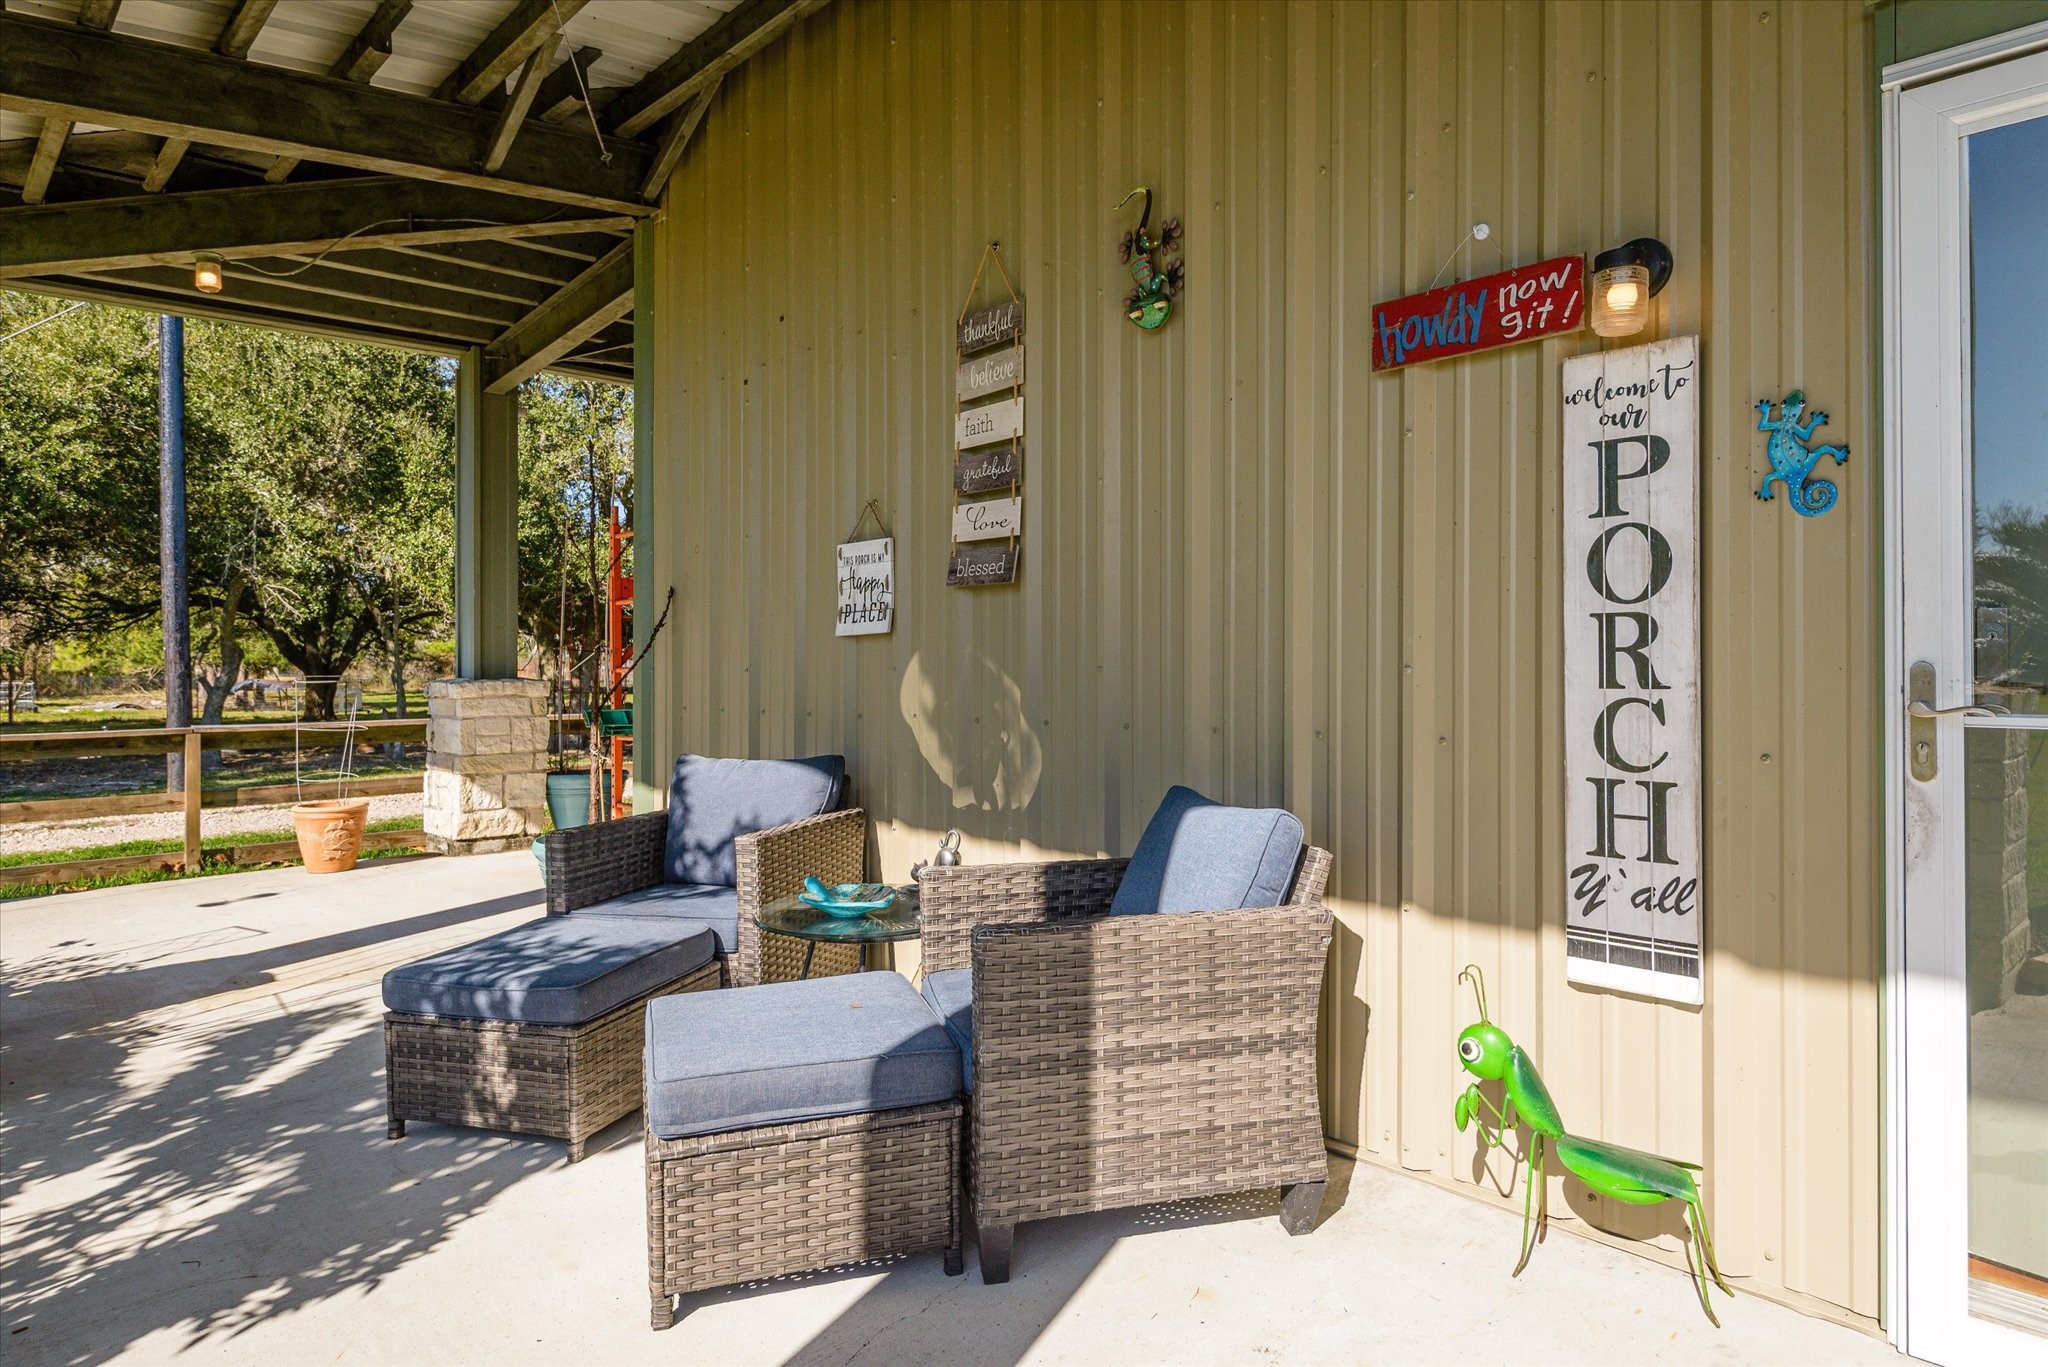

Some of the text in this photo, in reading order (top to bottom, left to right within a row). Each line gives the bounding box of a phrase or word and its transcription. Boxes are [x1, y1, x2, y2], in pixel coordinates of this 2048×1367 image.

[1499, 263, 1572, 313] now
[963, 304, 1014, 343] thankful
[1378, 288, 1488, 365] howdy
[970, 360, 1015, 389] believe
[1565, 360, 1694, 409] welcome to
[965, 413, 993, 437] faith
[1599, 403, 1648, 429] our
[962, 454, 1012, 491] grateful
[965, 506, 1011, 531] love
[843, 553, 885, 566] THIS PORCH IS MY
[956, 554, 1005, 578] blessed
[841, 566, 892, 602] Happy
[843, 601, 886, 624] PLACE
[1586, 434, 1679, 865] PORCH
